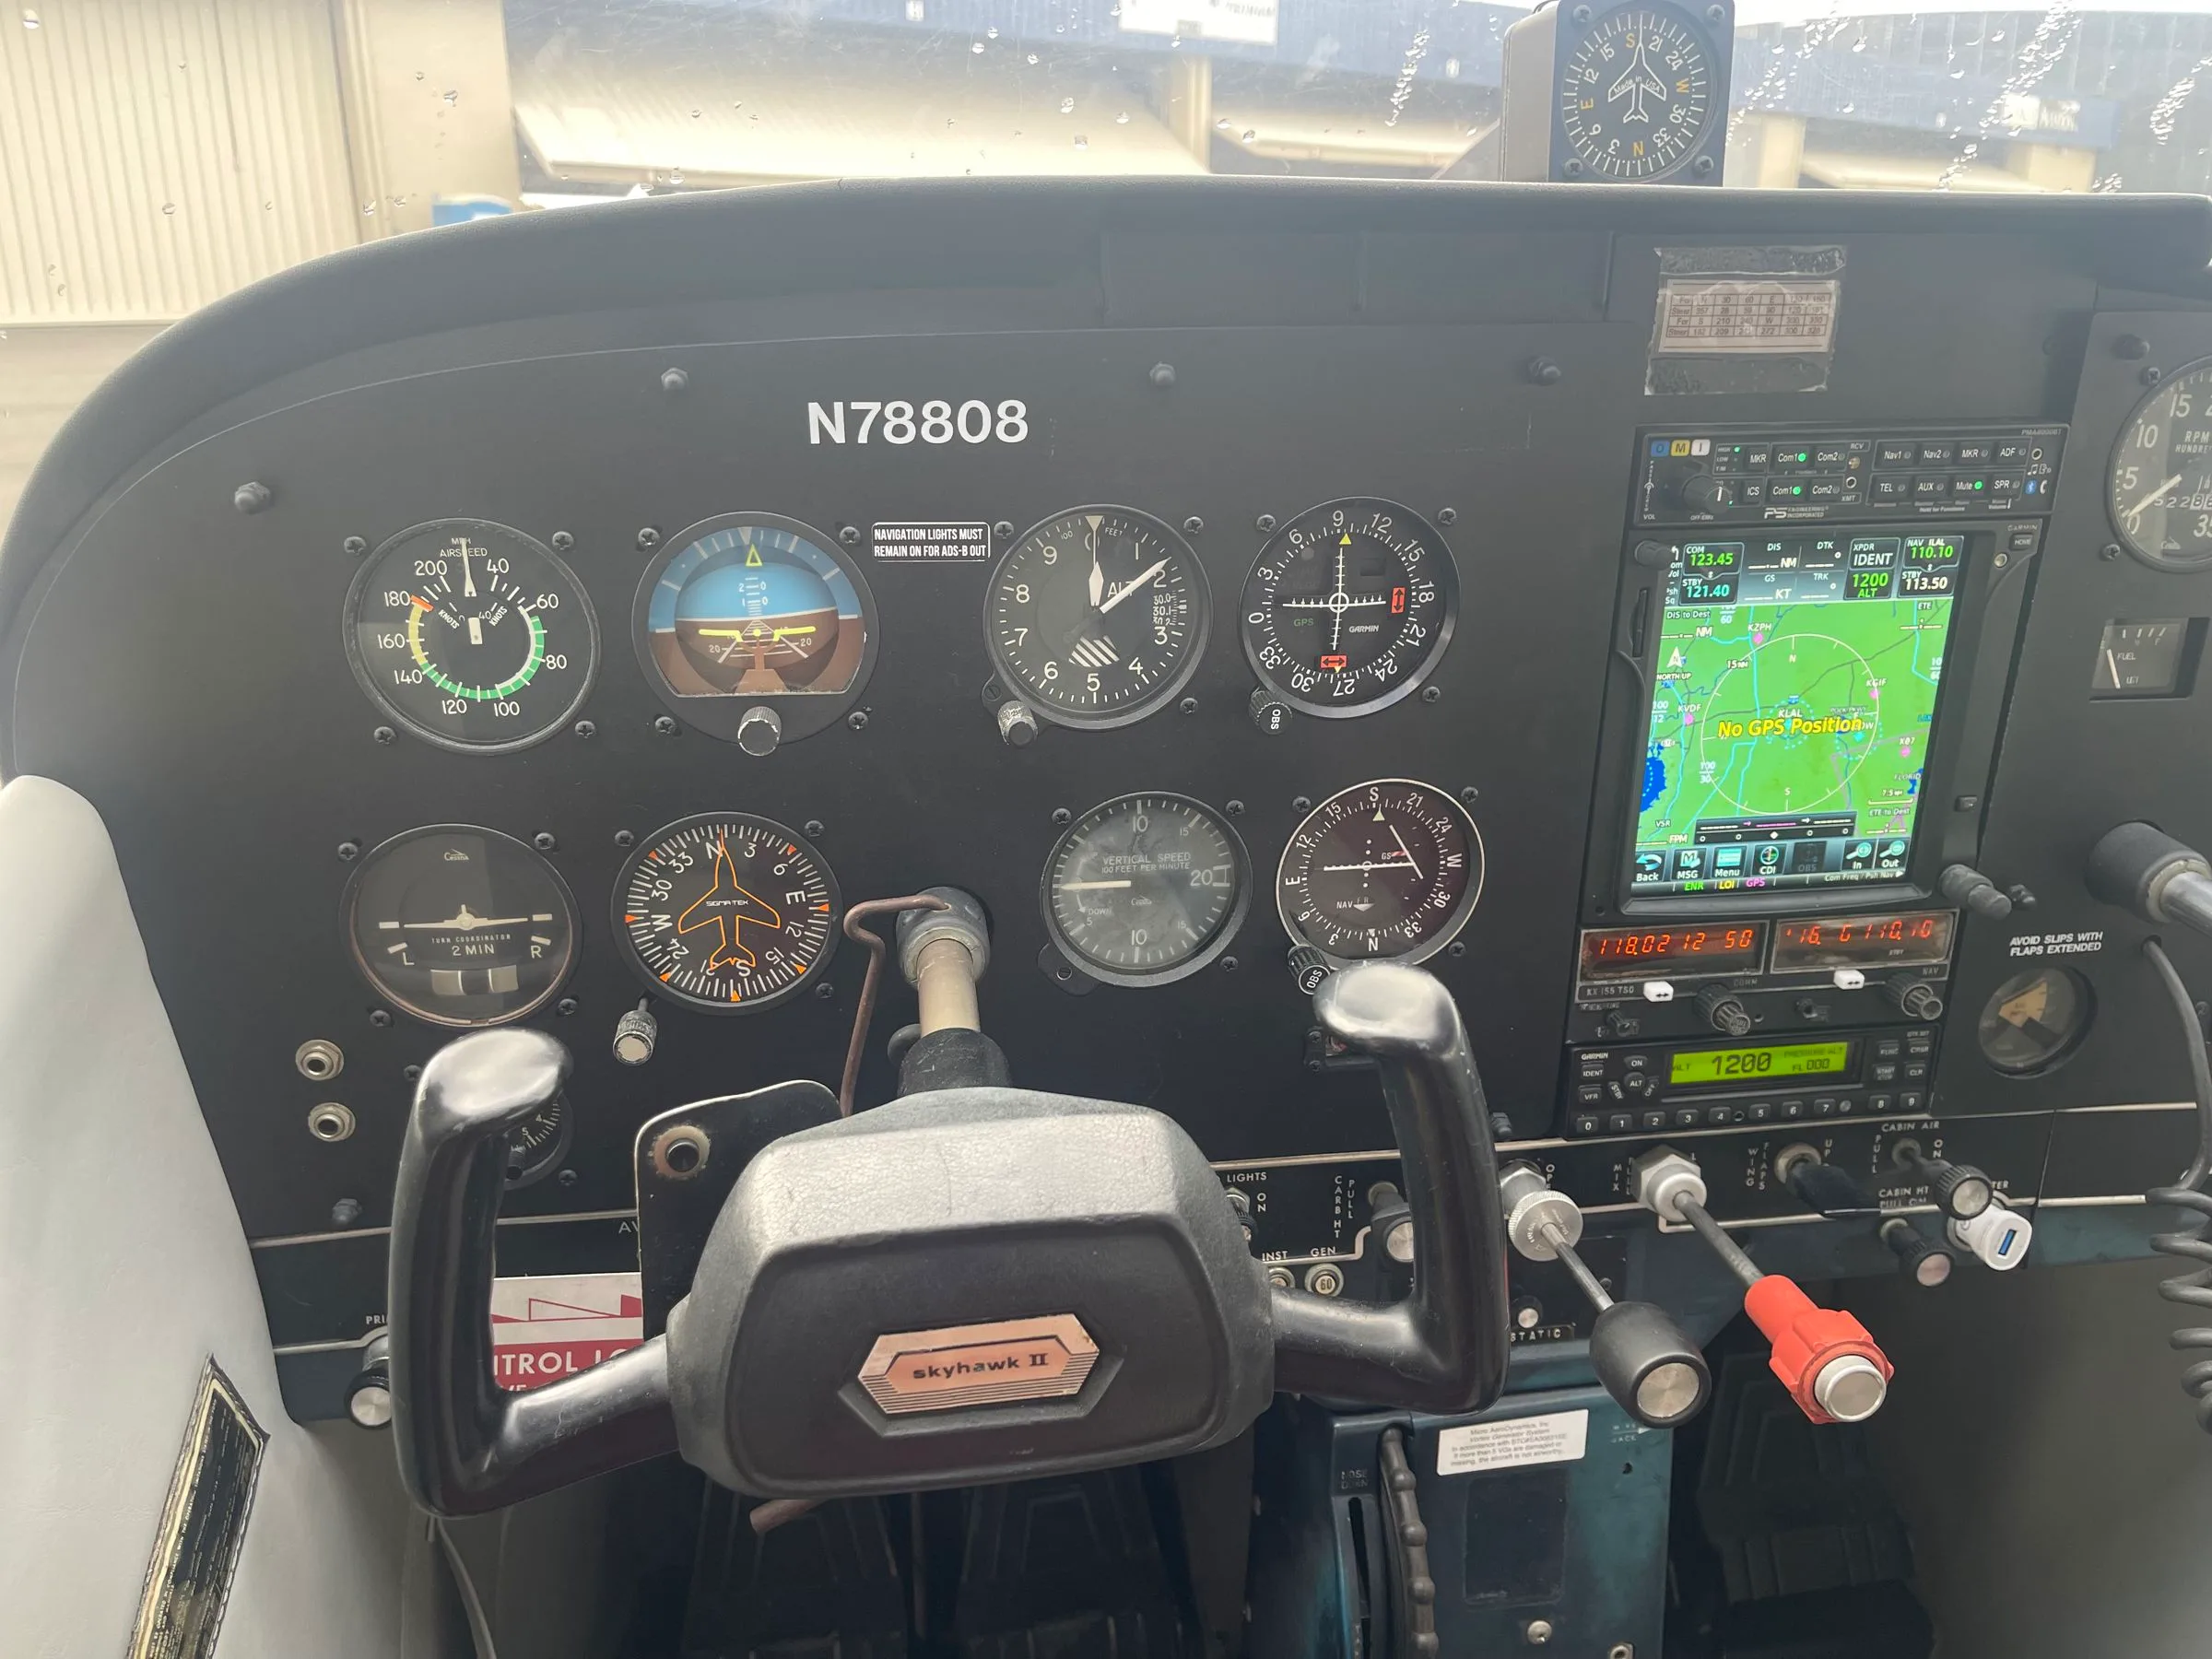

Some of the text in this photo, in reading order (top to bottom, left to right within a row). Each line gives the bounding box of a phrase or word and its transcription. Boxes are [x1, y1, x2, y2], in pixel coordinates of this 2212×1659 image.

[1614, 78, 1633, 95] Made
[1645, 79, 1661, 93] USA
[2170, 394, 2193, 418] 15
[807, 399, 1029, 444] N78808
[2136, 424, 2159, 449] 10
[2184, 430, 2210, 443] RPM
[1750, 452, 1838, 463] MKR Com1 Com2
[1884, 448, 2016, 460] Nav1 Nav2 MKR ADF
[2122, 466, 2139, 489] 5
[1747, 485, 1832, 496] ICS Com1 Com2
[1880, 480, 2009, 492] TEL AUX Mute SPR
[875, 528, 982, 541] NAVIGATION LIGHTS MUST
[1767, 543, 1782, 551] DIS
[1817, 541, 1834, 549] DTK
[1928, 537, 1946, 546] ILAL
[875, 545, 986, 558] REMAIN ON FOR ADS-B OUT
[1687, 546, 1704, 554] COM
[1911, 545, 1954, 559] 110.10
[1690, 553, 1734, 567] 123.45
[1780, 558, 1797, 568] NM
[1853, 552, 1893, 566] IDENT
[415, 560, 448, 576] 200
[487, 558, 510, 574] 40
[1764, 574, 1775, 582] GS
[1814, 572, 1830, 581] TRK
[1853, 572, 1888, 588] 1200
[1901, 571, 1922, 580] STBY
[1905, 577, 1948, 591] 113.50
[1687, 584, 1730, 598] 121.40
[1775, 589, 1792, 599] KT
[1858, 588, 1877, 598] ALT
[384, 591, 411, 607] 180
[536, 593, 559, 609] 60
[489, 606, 508, 627] KNOTS
[1153, 606, 1171, 617] 30.1
[1666, 611, 1680, 619] DIS
[1692, 610, 1711, 618] Dest
[438, 609, 460, 629] KNOTS
[1293, 618, 1314, 627] GPS
[1348, 625, 1380, 633] GARMIN
[1696, 626, 1712, 637] NM
[1748, 623, 1771, 631] KZPH
[378, 633, 406, 649] 160
[546, 654, 567, 670] 80
[2117, 652, 2136, 661] FUEL
[394, 669, 423, 685] 140
[442, 700, 467, 715] 120
[493, 701, 520, 717] 100
[1678, 704, 1701, 712] KVDF
[1778, 709, 1803, 718] KLAL
[1270, 708, 1282, 730] OBS
[1718, 715, 1863, 737] No GPS Position
[1669, 834, 1688, 844] FPM
[1102, 853, 1191, 865] VERTICAL SPEED
[1141, 864, 1158, 872] PER
[1159, 862, 1191, 870] MINUTE
[1636, 859, 1900, 882] Back MSG Menu CDI In Out
[1190, 869, 1213, 887] 20
[1684, 877, 1766, 890] ENR LOI GPS
[1336, 900, 1353, 909] NAV
[455, 934, 512, 943] COORDINATOR
[2009, 931, 2103, 947] AVOID SLIPS WITH
[452, 944, 495, 956] 2 MIN
[1600, 935, 1670, 956] 118.02
[2009, 942, 2101, 957] FLAPS EXTENDED
[1924, 968, 1939, 976] NAV
[1306, 970, 1323, 989] OBS
[1587, 986, 1634, 996] KX 155 TSO
[1581, 1052, 1609, 1060] GARMIN
[1712, 1052, 1772, 1076] 1200
[1881, 1121, 1940, 1133] CABIN AIR
[1825, 1139, 1833, 1158] UP
[1747, 1148, 1758, 1187] WING
[1227, 1171, 1267, 1182] LIGHTS
[1613, 1164, 1622, 1192] MIX
[1878, 1186, 1929, 1198] CABIN HT
[1256, 1193, 1266, 1213] ON
[1334, 1175, 1343, 1239] CARB HT
[1262, 1251, 1288, 1262] INST
[1310, 1246, 1336, 1257] GEN
[1511, 1328, 1561, 1343] STATIC
[912, 1353, 1048, 1379] skyhawk II
